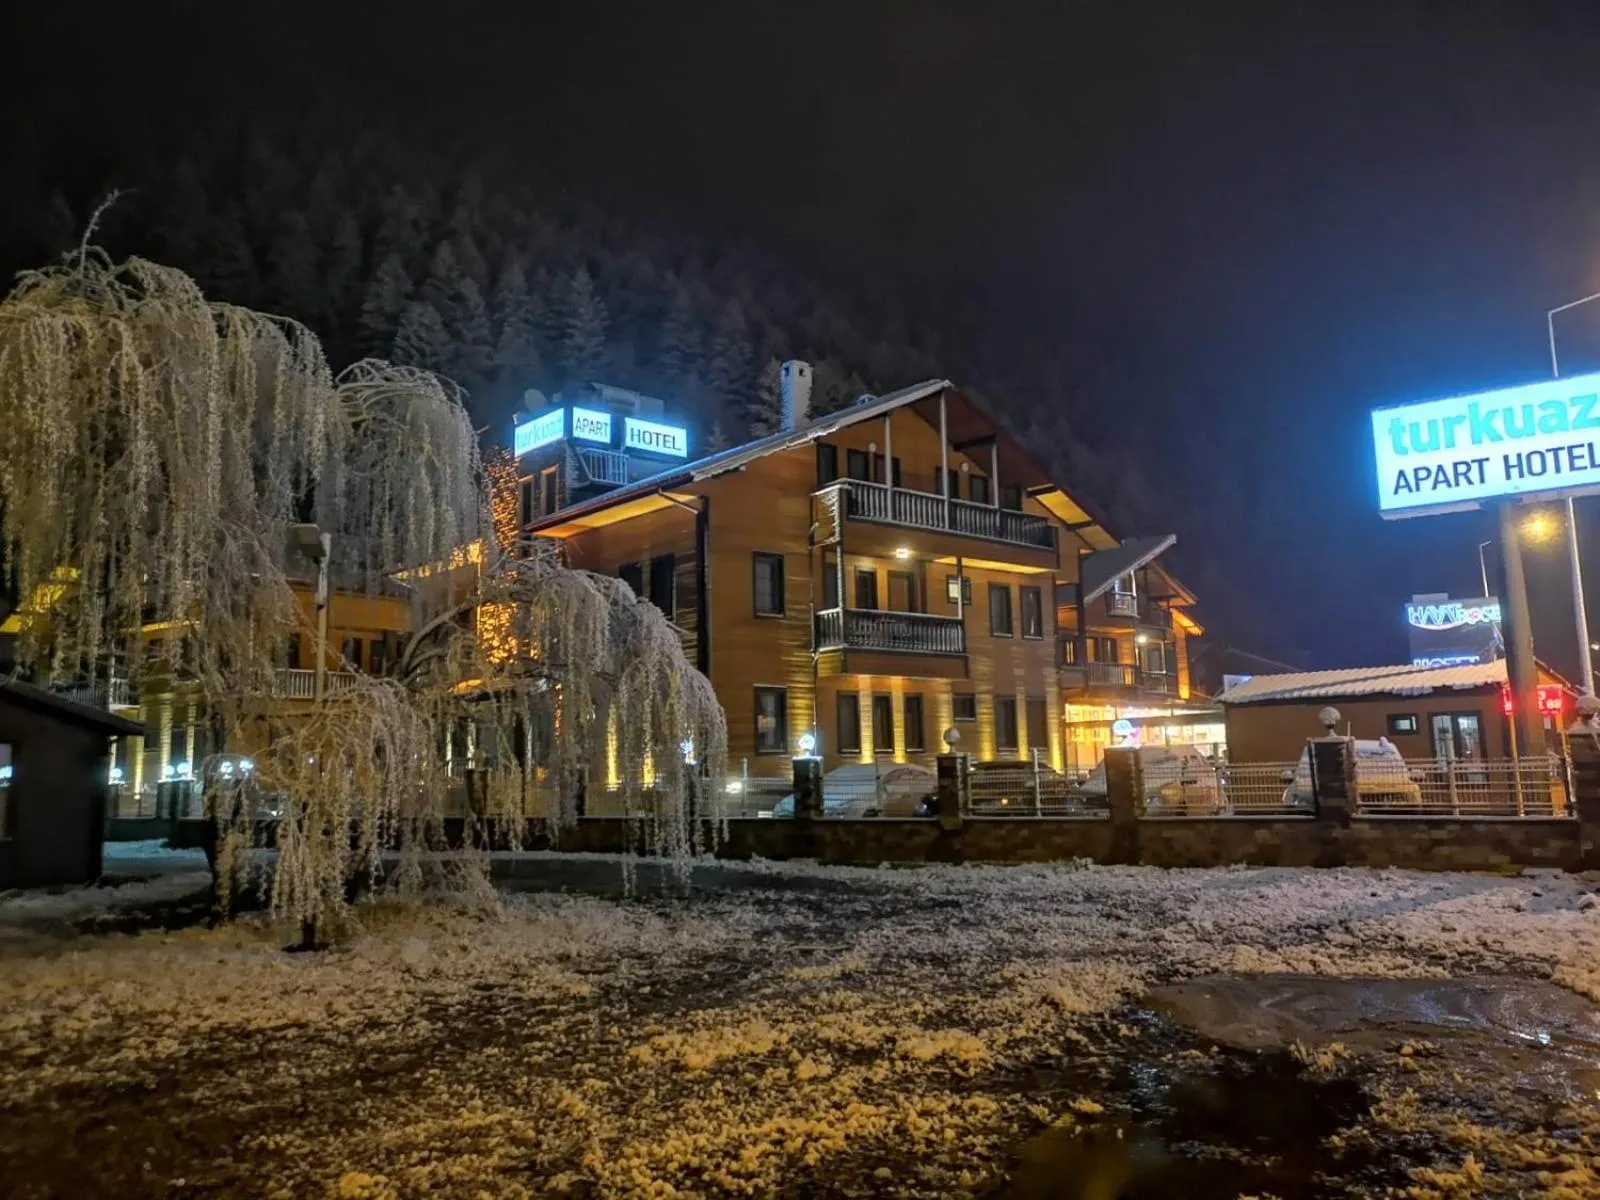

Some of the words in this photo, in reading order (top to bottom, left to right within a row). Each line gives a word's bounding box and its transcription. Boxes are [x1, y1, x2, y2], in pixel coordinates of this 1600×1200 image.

[575, 418, 609, 443] APART
[630, 427, 682, 451] HOTEL
[1388, 394, 1600, 456] turkuaz
[1393, 457, 1490, 496] APART
[1503, 442, 1600, 481] HOTEL
